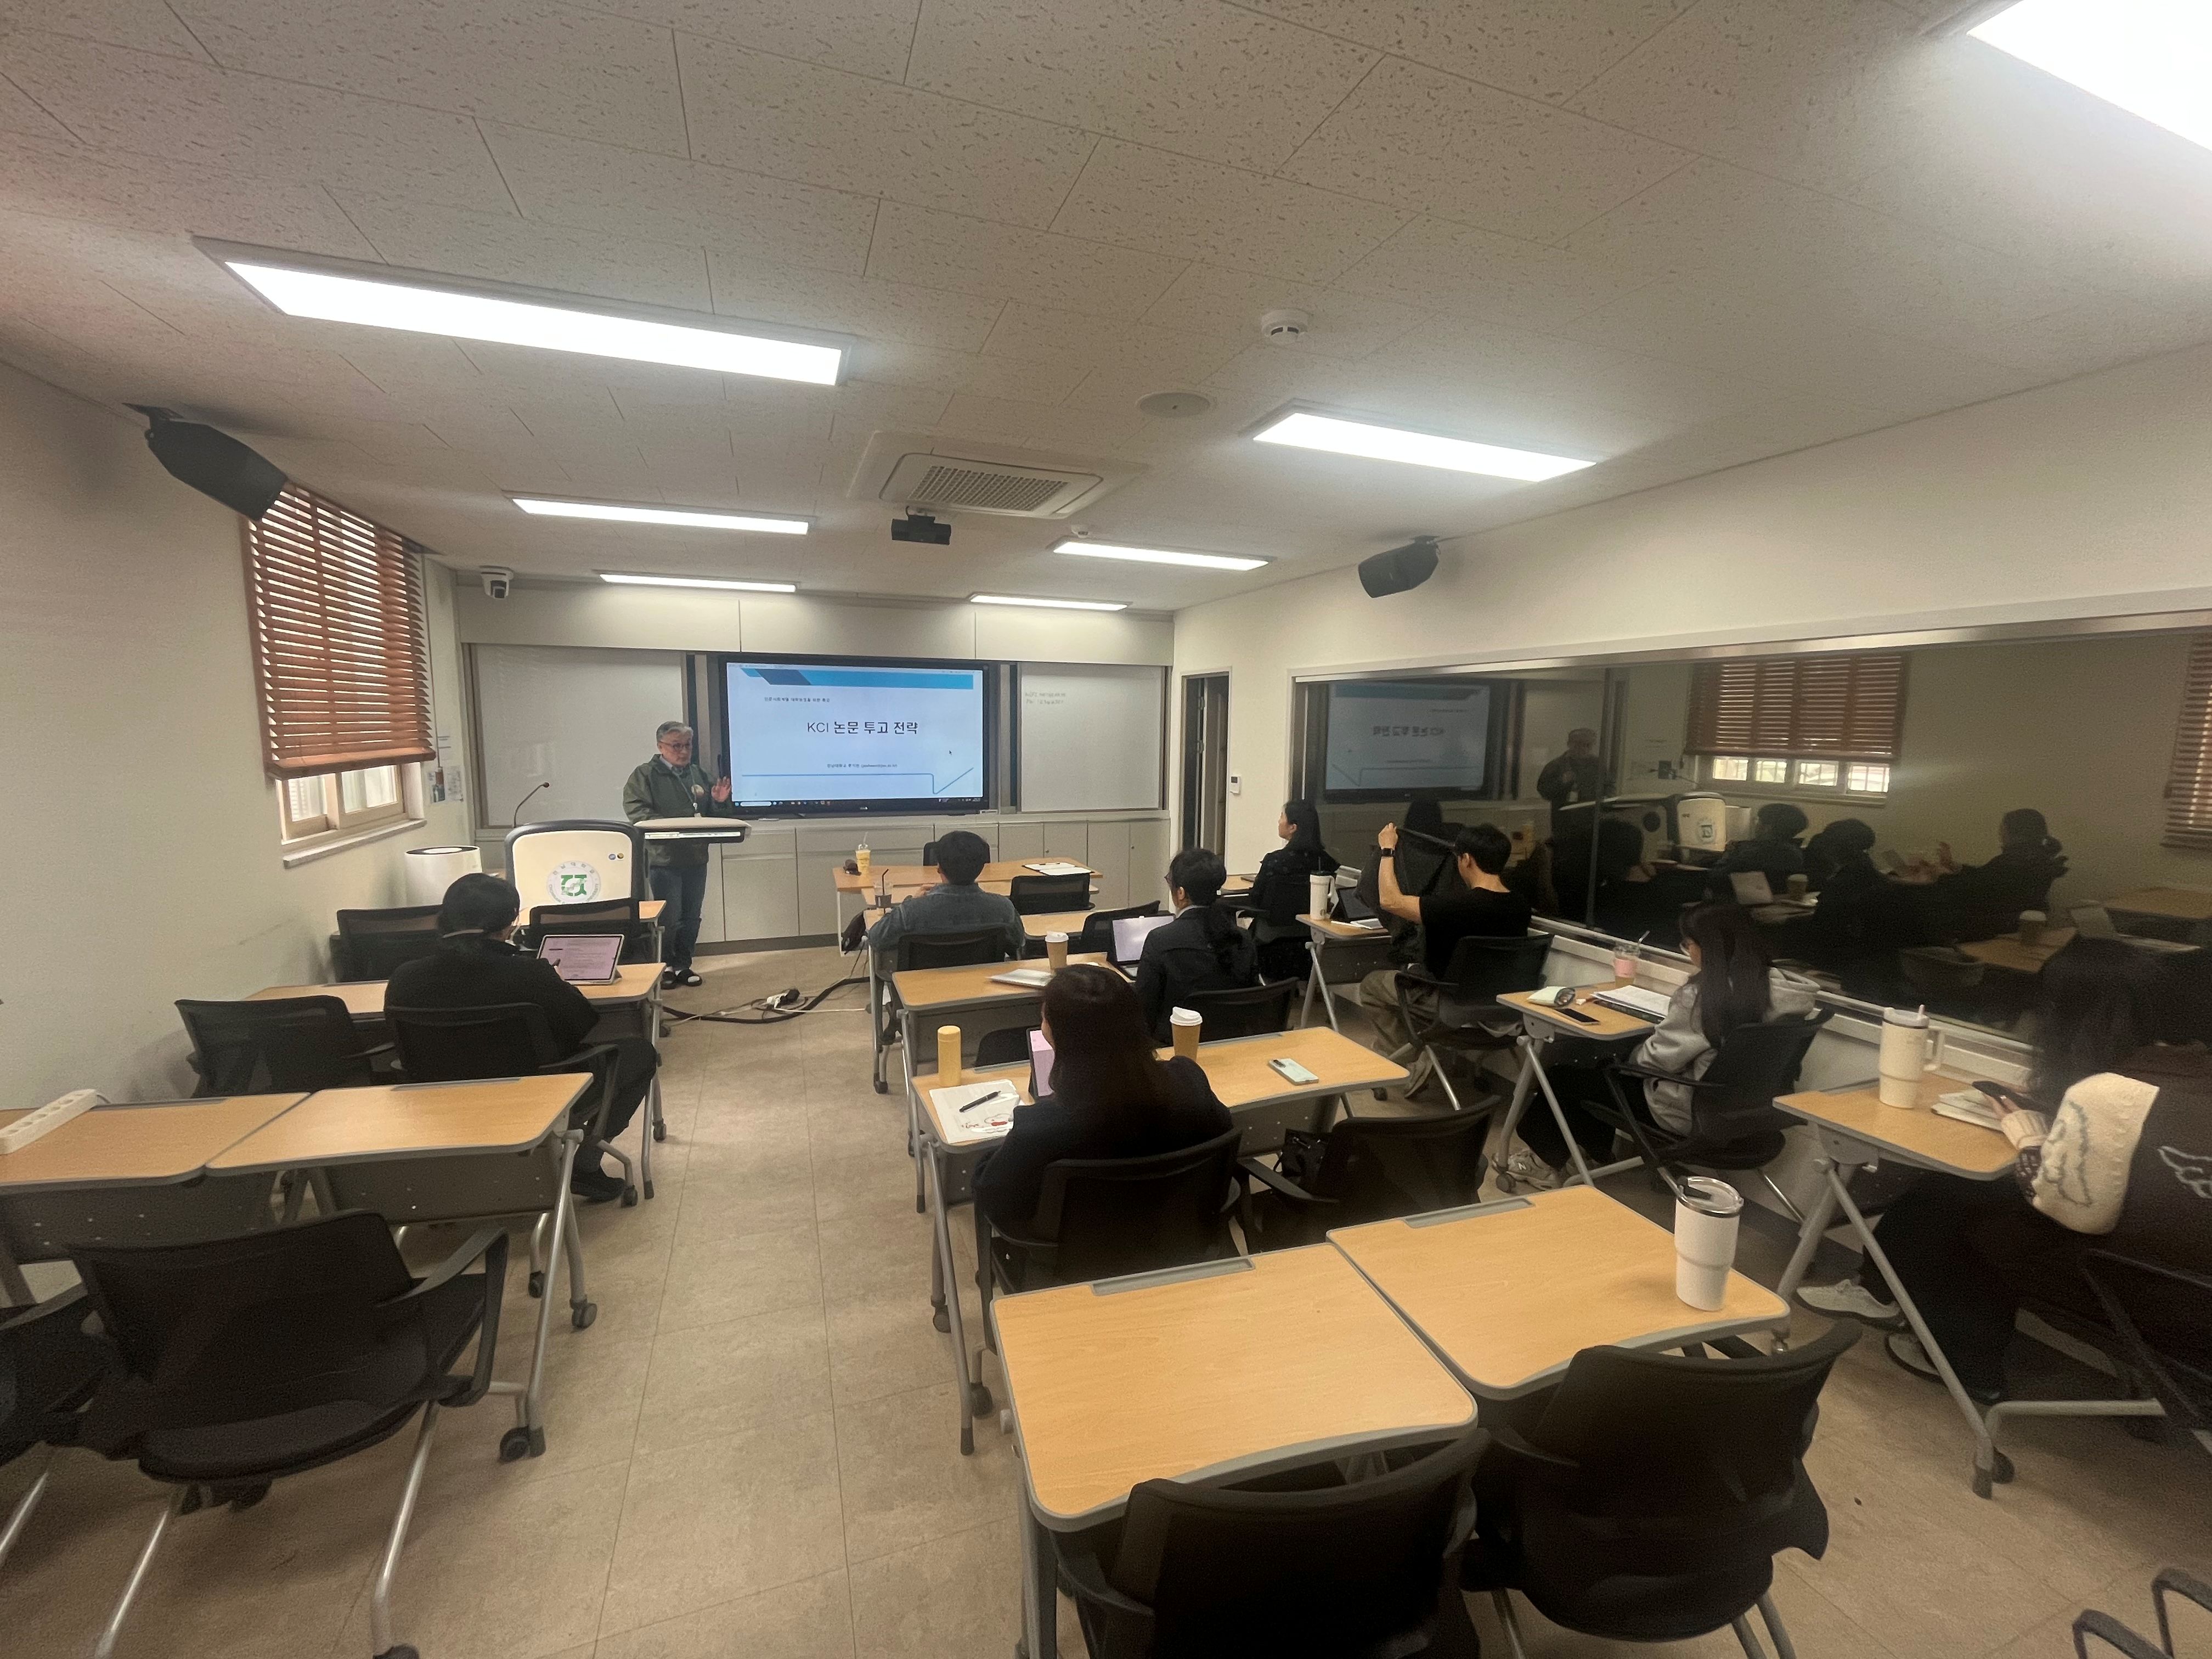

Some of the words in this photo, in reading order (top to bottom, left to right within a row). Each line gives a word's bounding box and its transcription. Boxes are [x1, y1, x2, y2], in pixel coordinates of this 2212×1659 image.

[807, 722, 828, 732] KCI
[833, 721, 859, 734] 논문
[864, 721, 888, 734] 투고
[894, 721, 918, 735] 전략
